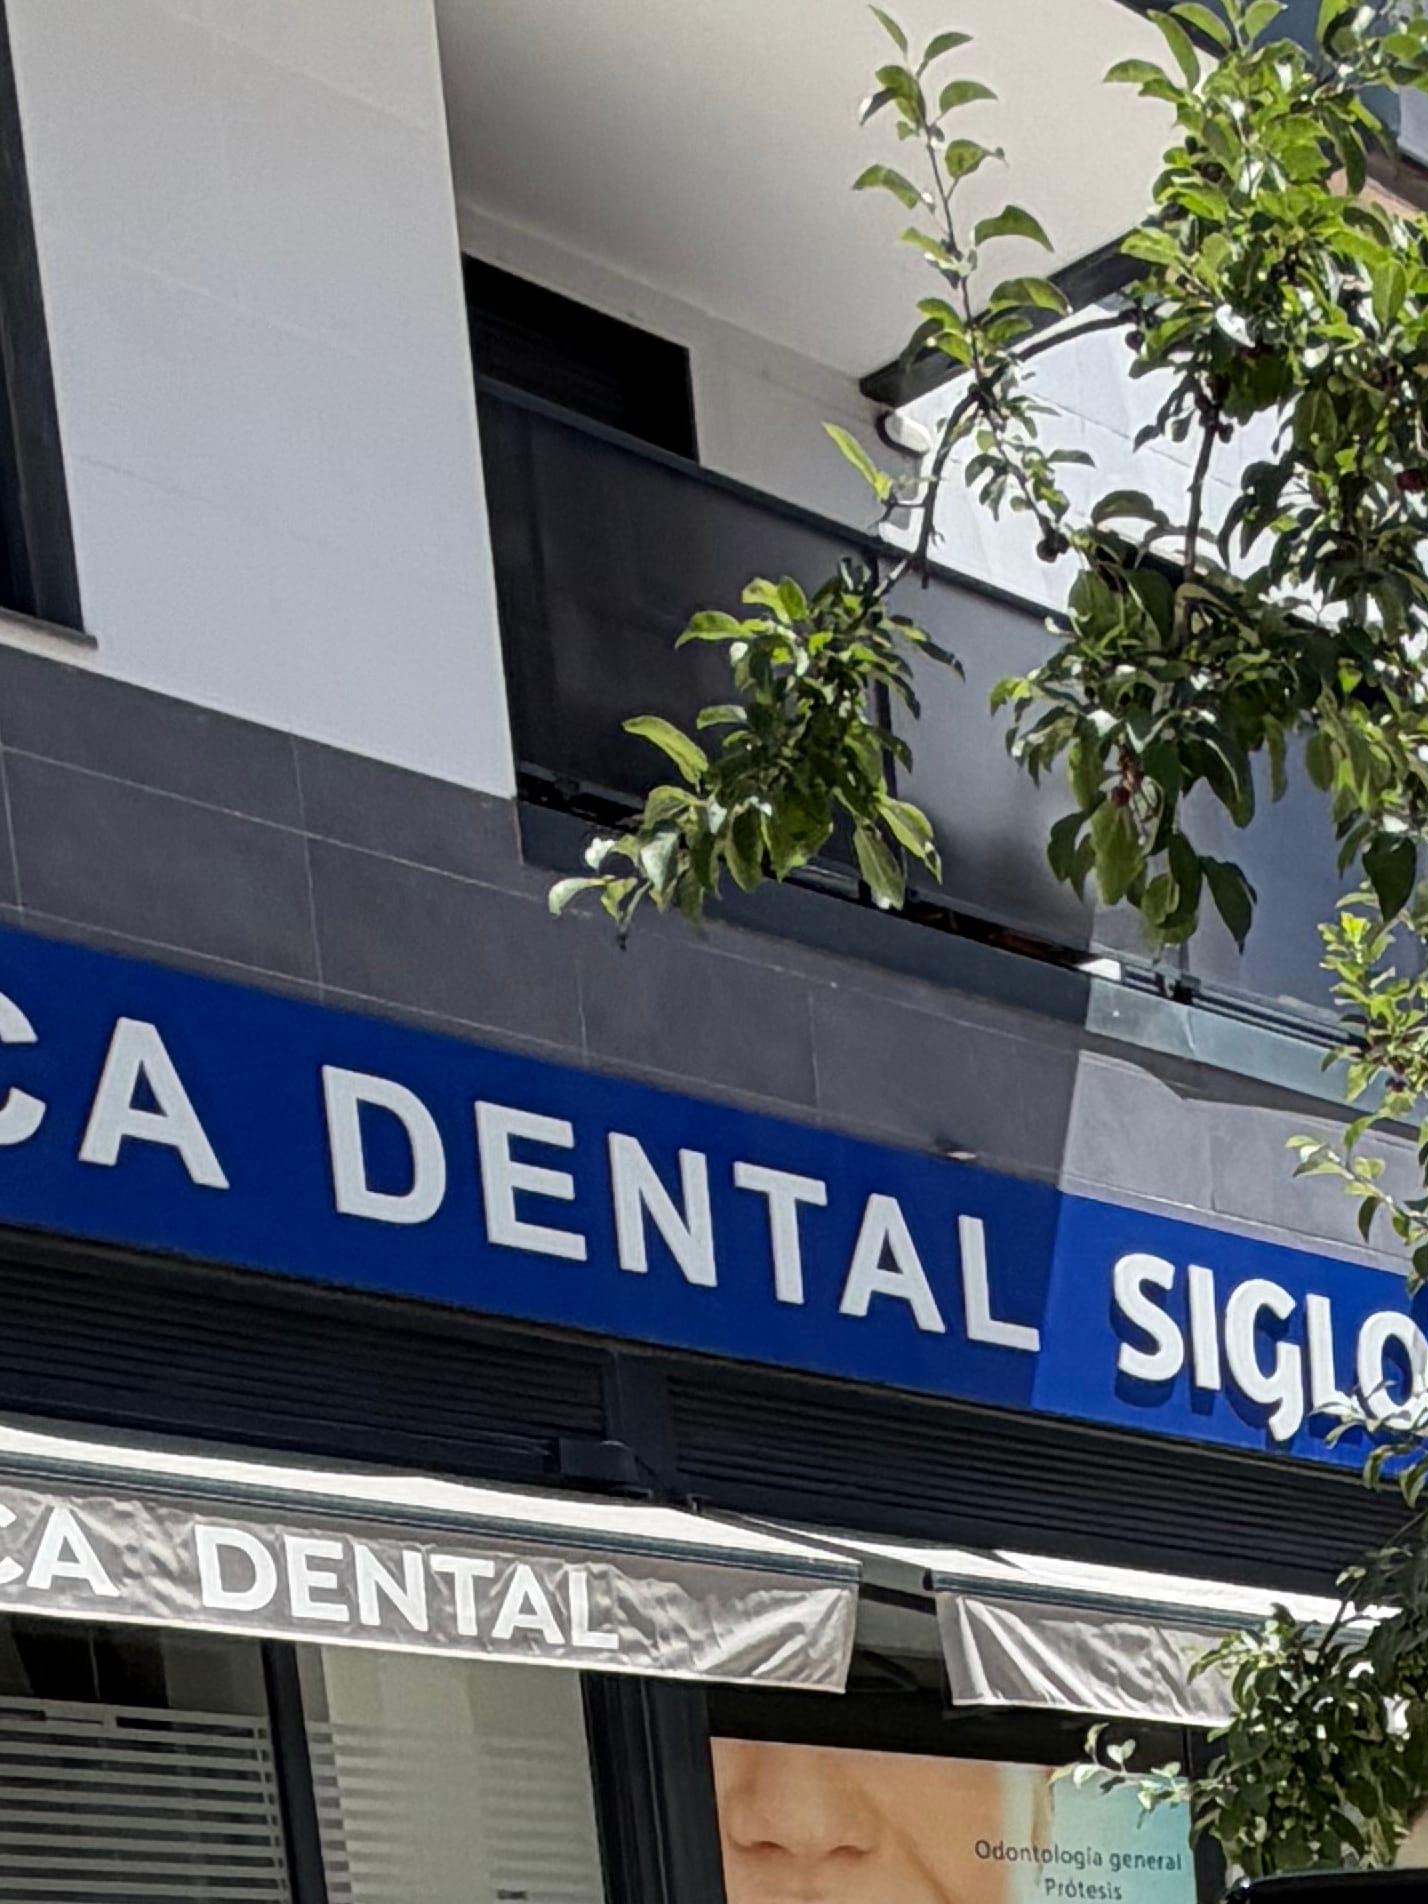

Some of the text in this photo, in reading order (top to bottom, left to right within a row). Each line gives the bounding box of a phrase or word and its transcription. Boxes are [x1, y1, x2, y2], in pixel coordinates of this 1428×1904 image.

[321, 1064, 1040, 1352] DENTAL
[194, 1524, 620, 1650] DENTAL
[974, 1840, 1182, 1872] Odontología general
[1044, 1878, 1123, 1901] Prótesis
